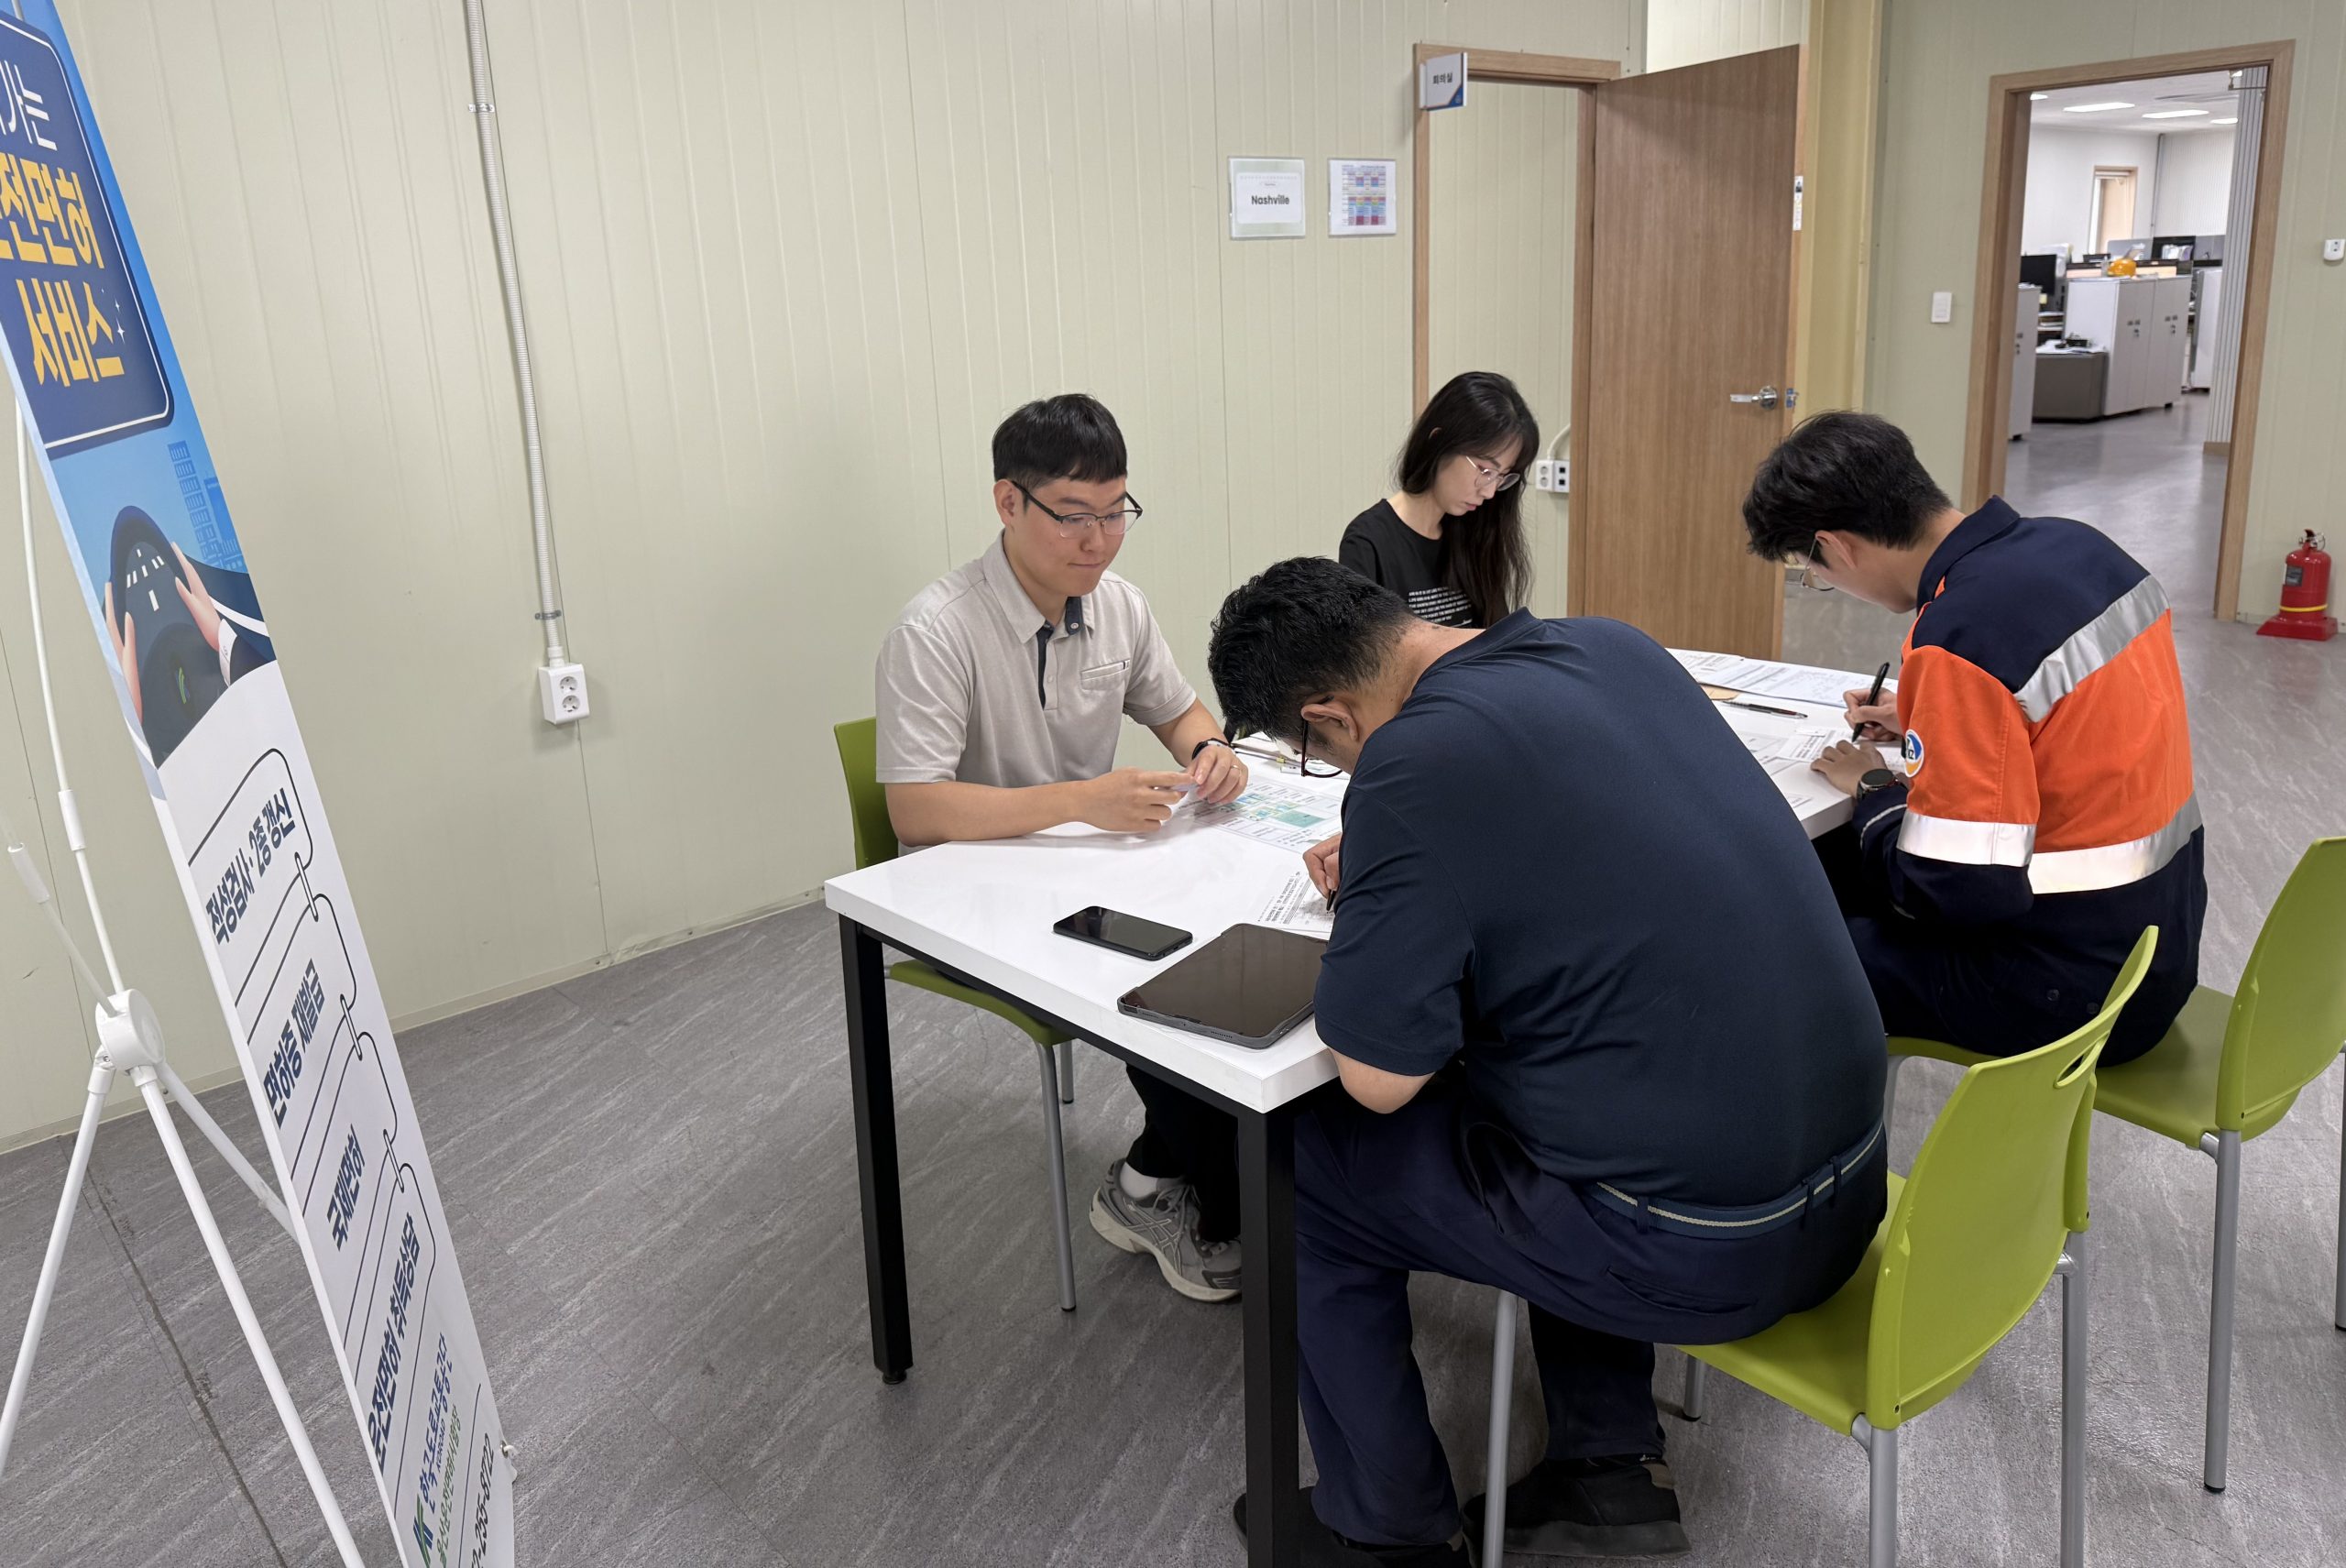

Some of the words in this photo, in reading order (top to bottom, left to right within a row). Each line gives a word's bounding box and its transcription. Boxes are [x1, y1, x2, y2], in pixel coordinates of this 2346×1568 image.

[0, 59, 58, 151] 가는
[1251, 194, 1290, 205] Nashville
[16, 277, 125, 388] 서비스
[261, 787, 296, 850] 갱신
[263, 1018, 302, 1130] 면허증
[291, 957, 325, 1054] 재발급
[326, 1123, 366, 1253] 국제면허
[367, 1316, 401, 1477] 운전면허
[419, 1332, 453, 1515] 한국도로교통공단
[471, 1431, 495, 1568] 2-255-8722
